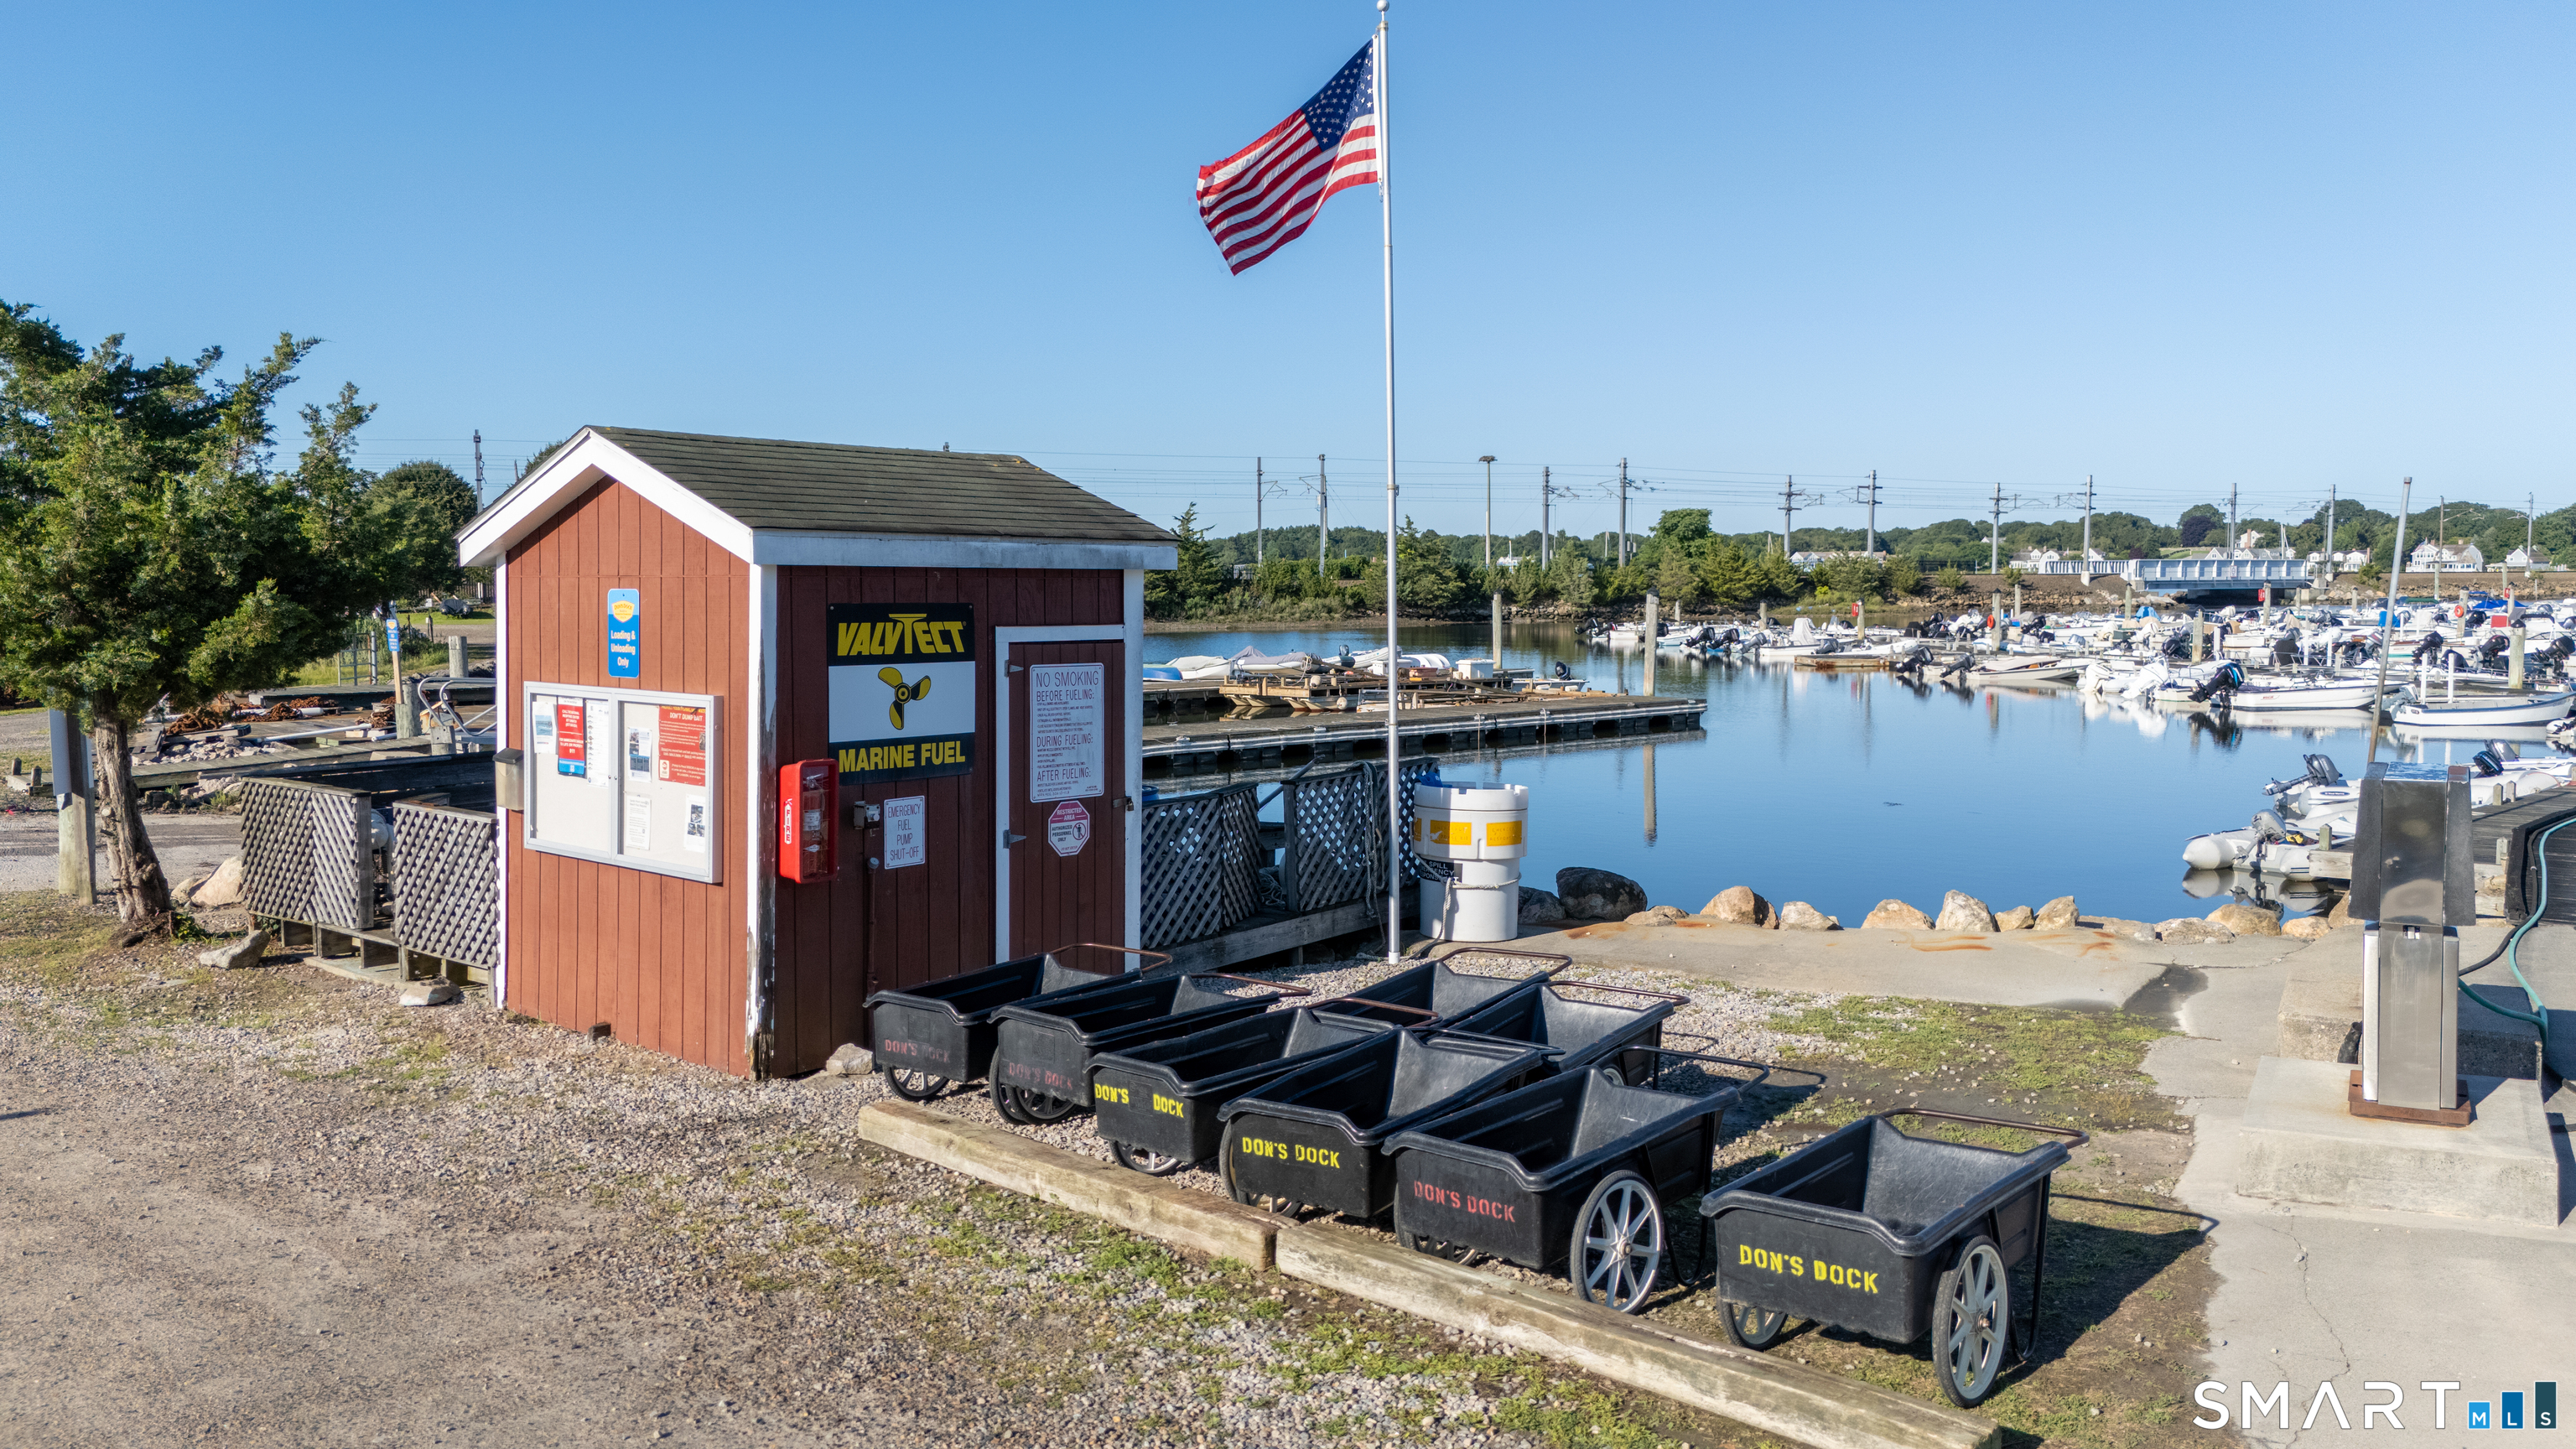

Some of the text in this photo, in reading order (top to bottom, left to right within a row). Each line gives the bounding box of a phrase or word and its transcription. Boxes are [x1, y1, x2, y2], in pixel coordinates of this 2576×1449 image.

[610, 630, 636, 641] Loading &
[837, 613, 964, 657] VALVTECT
[610, 643, 636, 655] Unloading
[617, 657, 629, 668] Only
[1036, 671, 1099, 688] NO SMOKING
[1036, 688, 1094, 702] BEFORE FUELING:
[1036, 733, 1093, 748] DURING FUELING:
[839, 740, 966, 774] MARINE FUEL
[1036, 766, 1091, 782] AFTER FUELING:
[888, 803, 922, 818] EMERGENCY
[897, 818, 911, 831] FUEL
[896, 833, 913, 846] PUMP
[890, 845, 919, 861] SHUT-OFF
[1429, 860, 1448, 870] SPILL
[885, 1038, 917, 1057] DON'S
[1009, 1062, 1073, 1091] DON'S DOCK
[1094, 1083, 1130, 1104] DON'S
[1153, 1093, 1184, 1119] DOCK
[1242, 1136, 1341, 1169] DON'S DOCK
[1414, 1180, 1516, 1223] DON'S DOCK
[1739, 1244, 1879, 1294] DON'S DOCK
